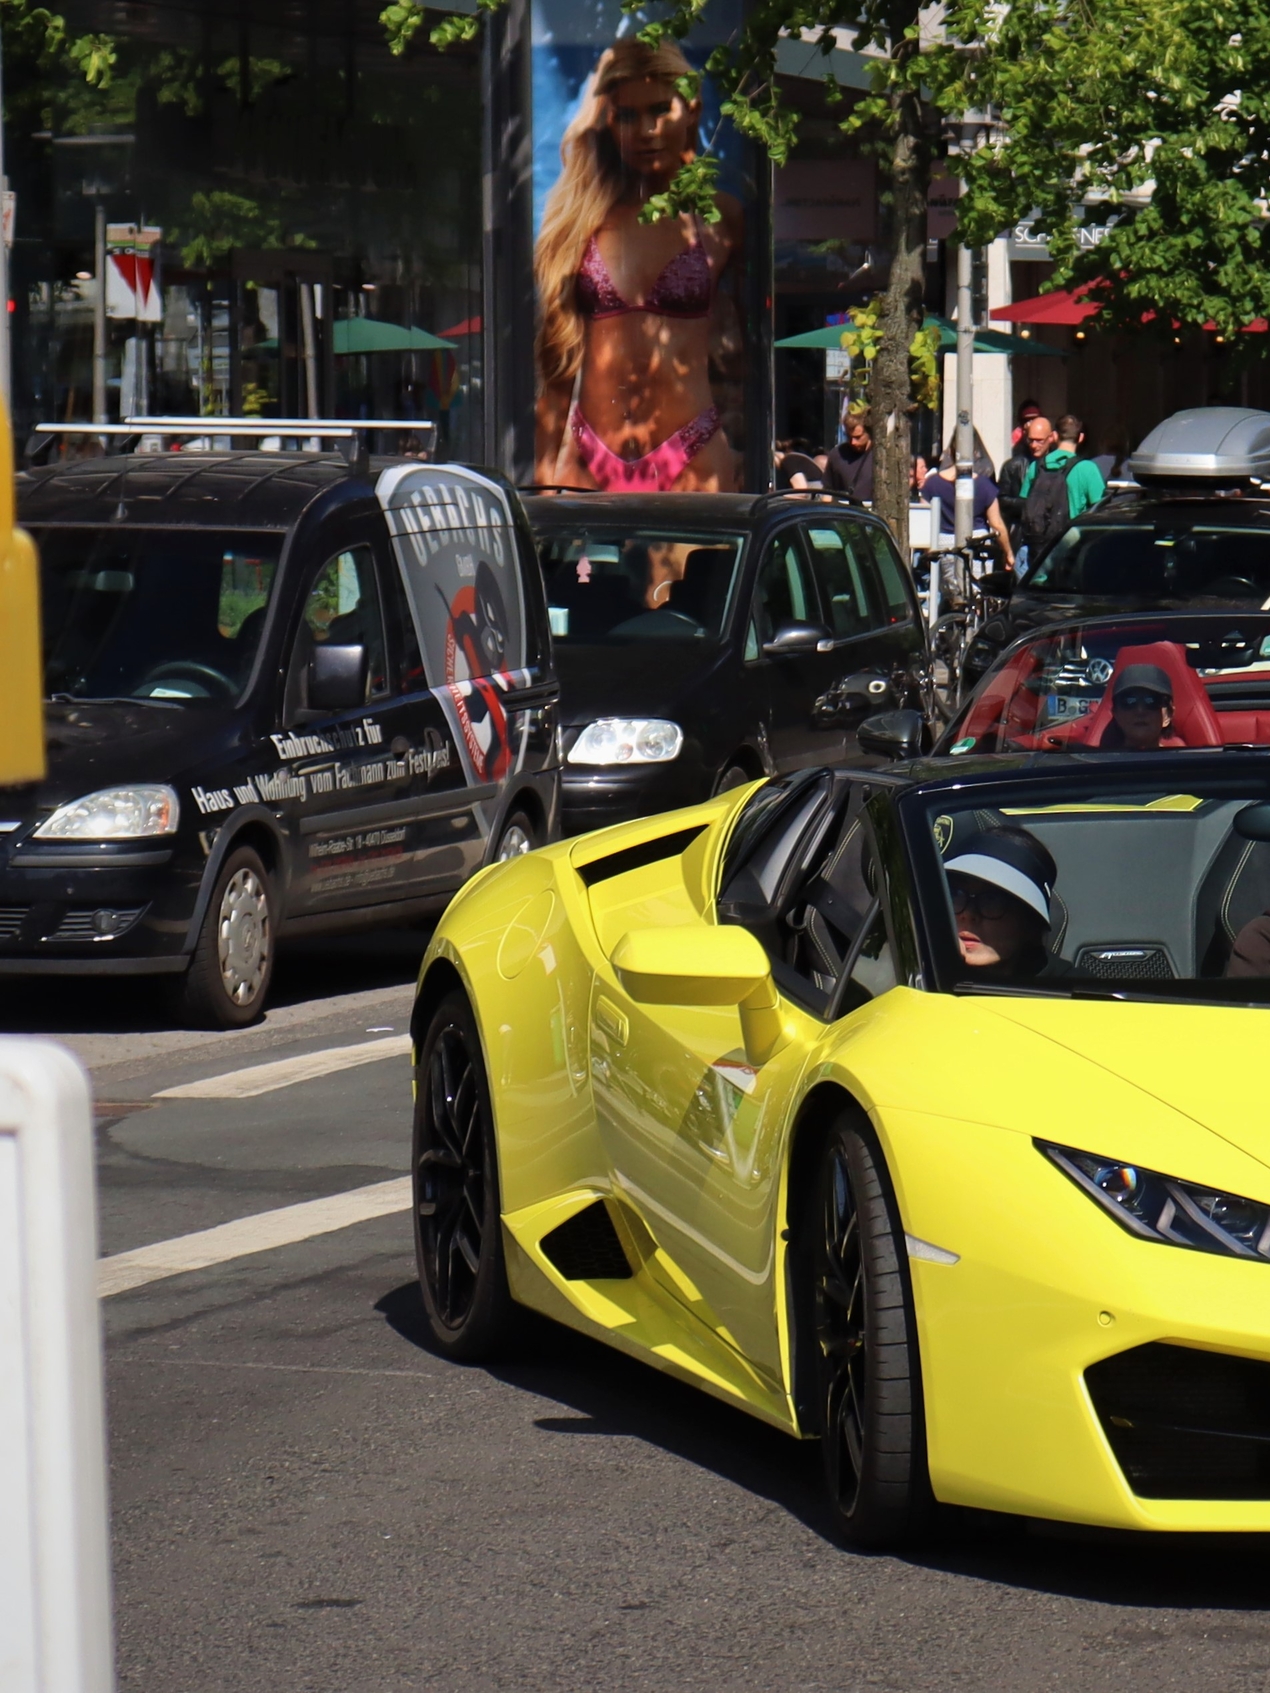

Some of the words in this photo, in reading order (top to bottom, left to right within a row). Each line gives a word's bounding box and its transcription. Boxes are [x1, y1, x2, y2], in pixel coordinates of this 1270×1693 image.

[1057, 699, 1067, 714] B
[269, 724, 363, 760] Einbruchschutz
[363, 718, 382, 745] für
[191, 786, 235, 814] Haus
[233, 776, 259, 805] und
[254, 772, 307, 803] Wohnung
[310, 773, 332, 794] vom
[334, 760, 385, 790] Fachmann
[386, 759, 405, 781] zum
